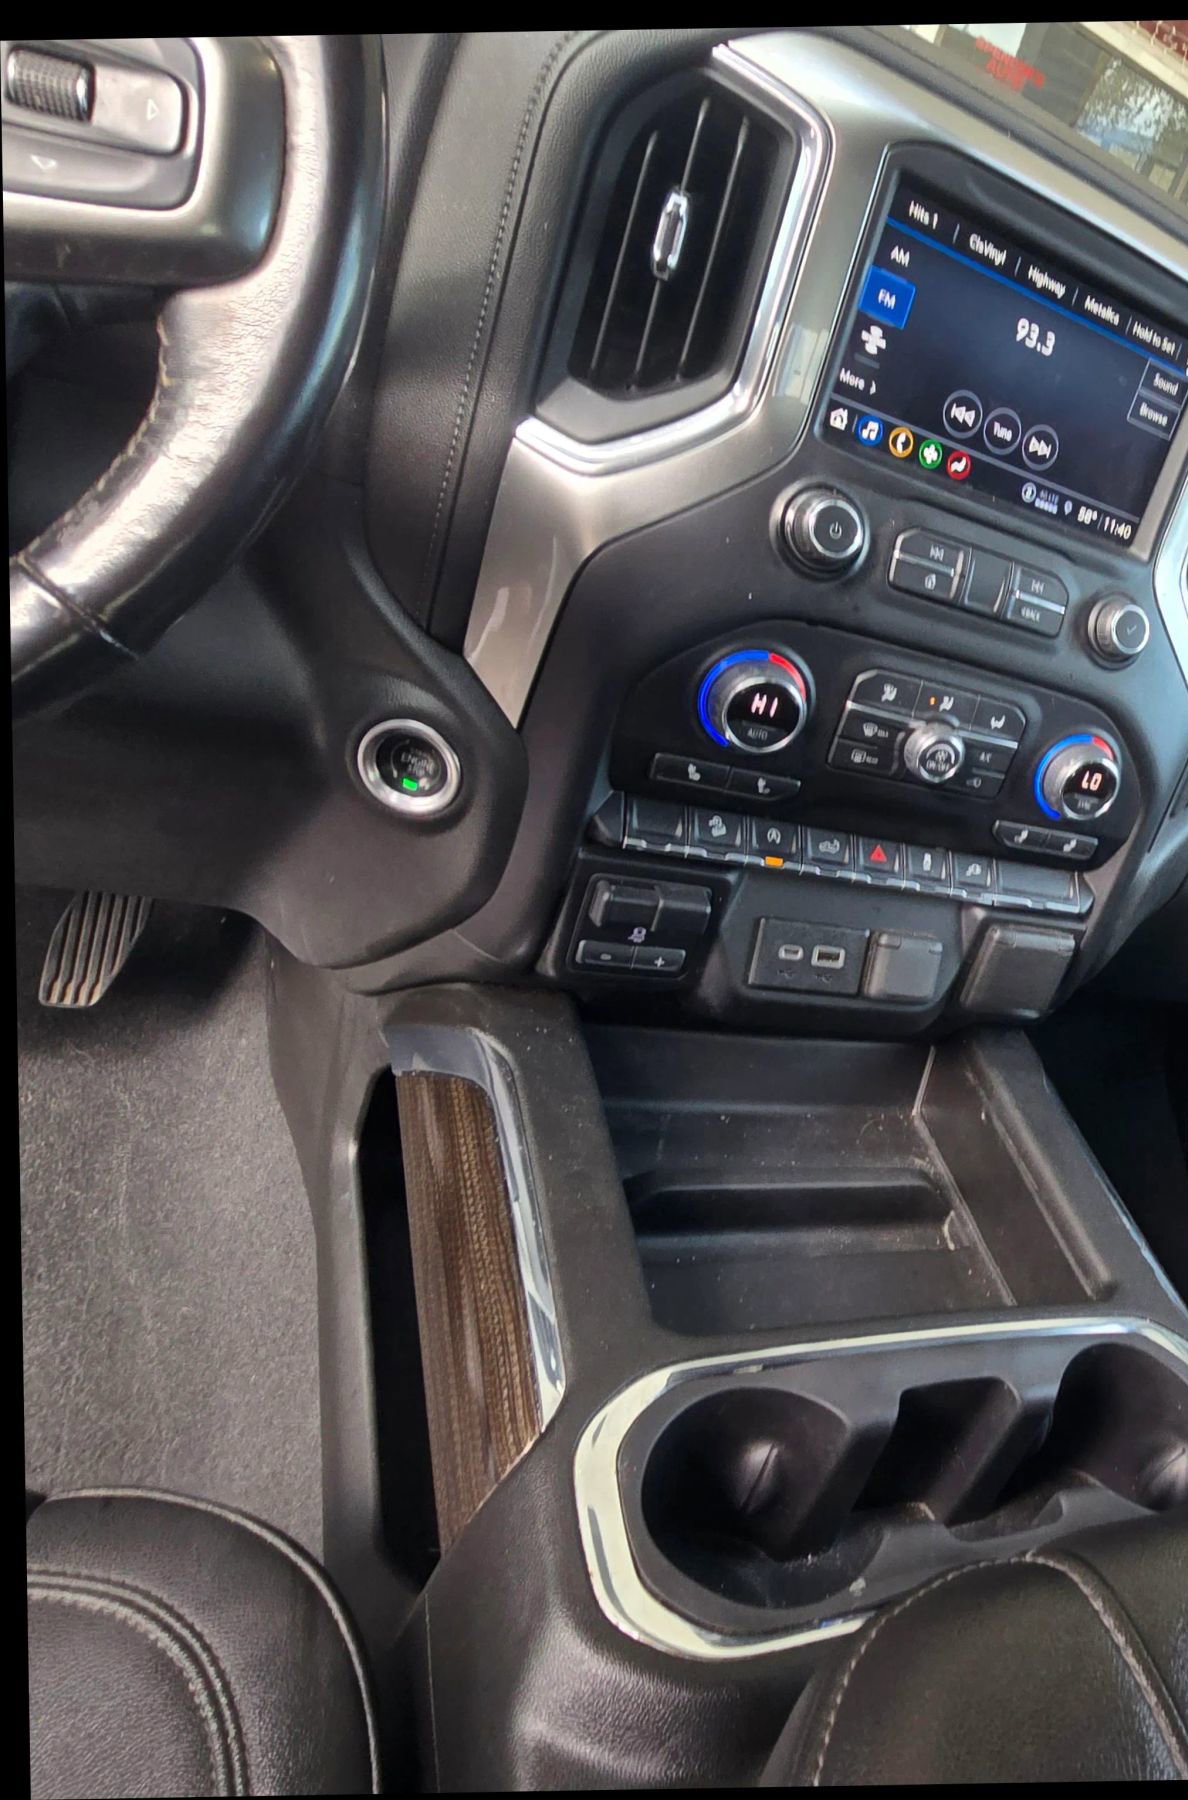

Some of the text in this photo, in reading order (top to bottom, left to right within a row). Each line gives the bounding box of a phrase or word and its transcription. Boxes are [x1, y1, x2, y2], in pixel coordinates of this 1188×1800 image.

[890, 245, 910, 268] AM
[1028, 264, 1066, 299] Highway
[877, 288, 896, 310] FM
[1016, 318, 1055, 356] 93.3
[839, 367, 865, 391] More
[1153, 372, 1179, 396] Sound
[1139, 402, 1168, 426] Browse
[1104, 516, 1132, 540] 11:40
[751, 692, 778, 718] HI
[1081, 770, 1103, 791] LO
